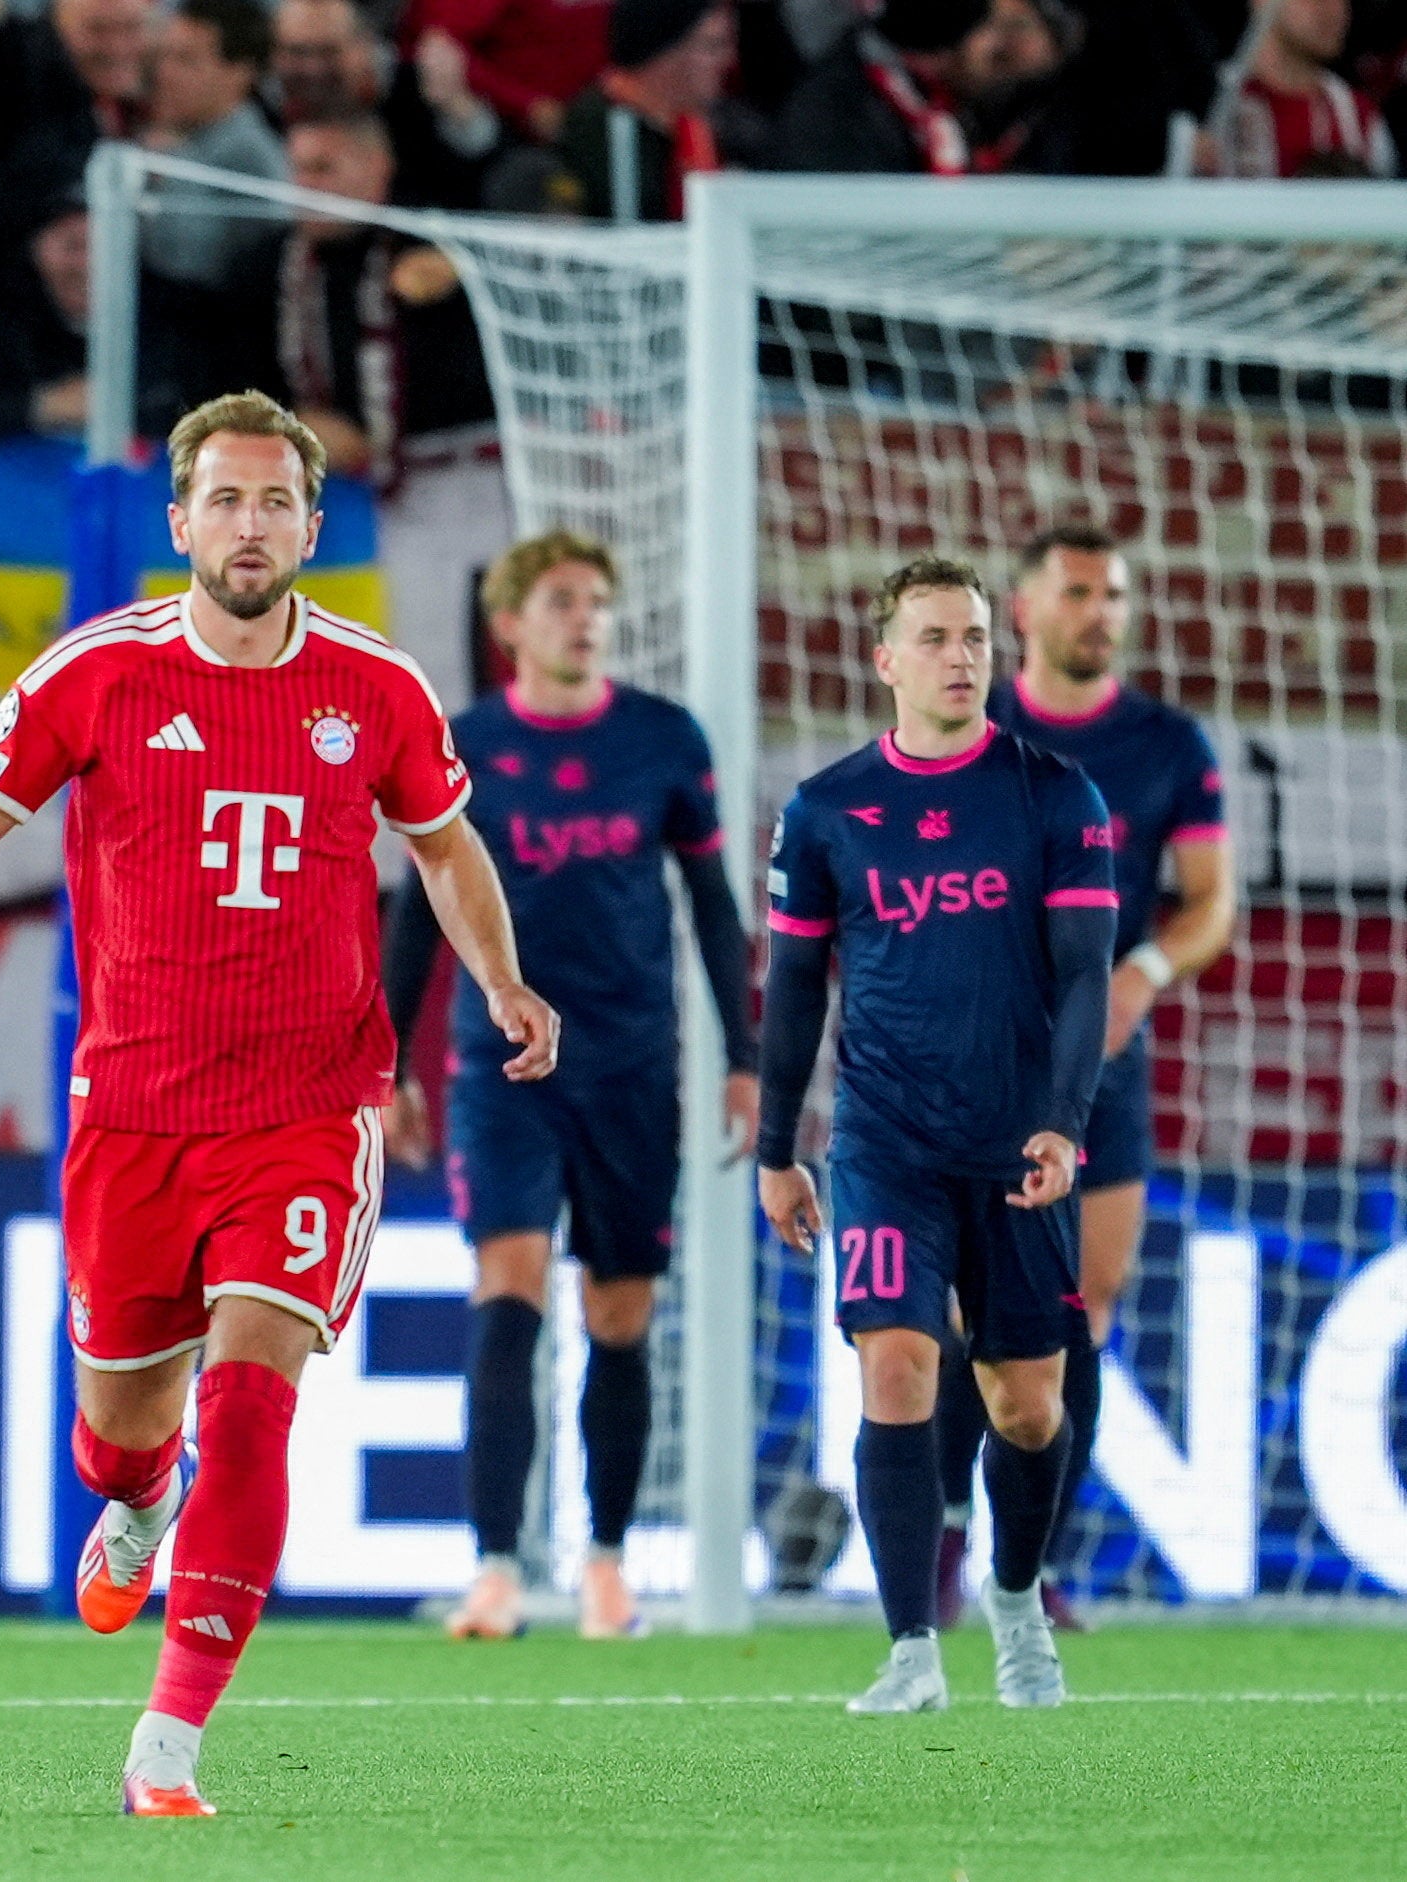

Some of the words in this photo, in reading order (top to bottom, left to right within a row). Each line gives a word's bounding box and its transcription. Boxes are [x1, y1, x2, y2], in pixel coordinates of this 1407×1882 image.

[200, 789, 305, 909] T
[509, 814, 640, 873] Lyse
[867, 867, 1009, 933] Lyse
[283, 1196, 327, 1275] 9
[841, 1226, 905, 1300] 20
